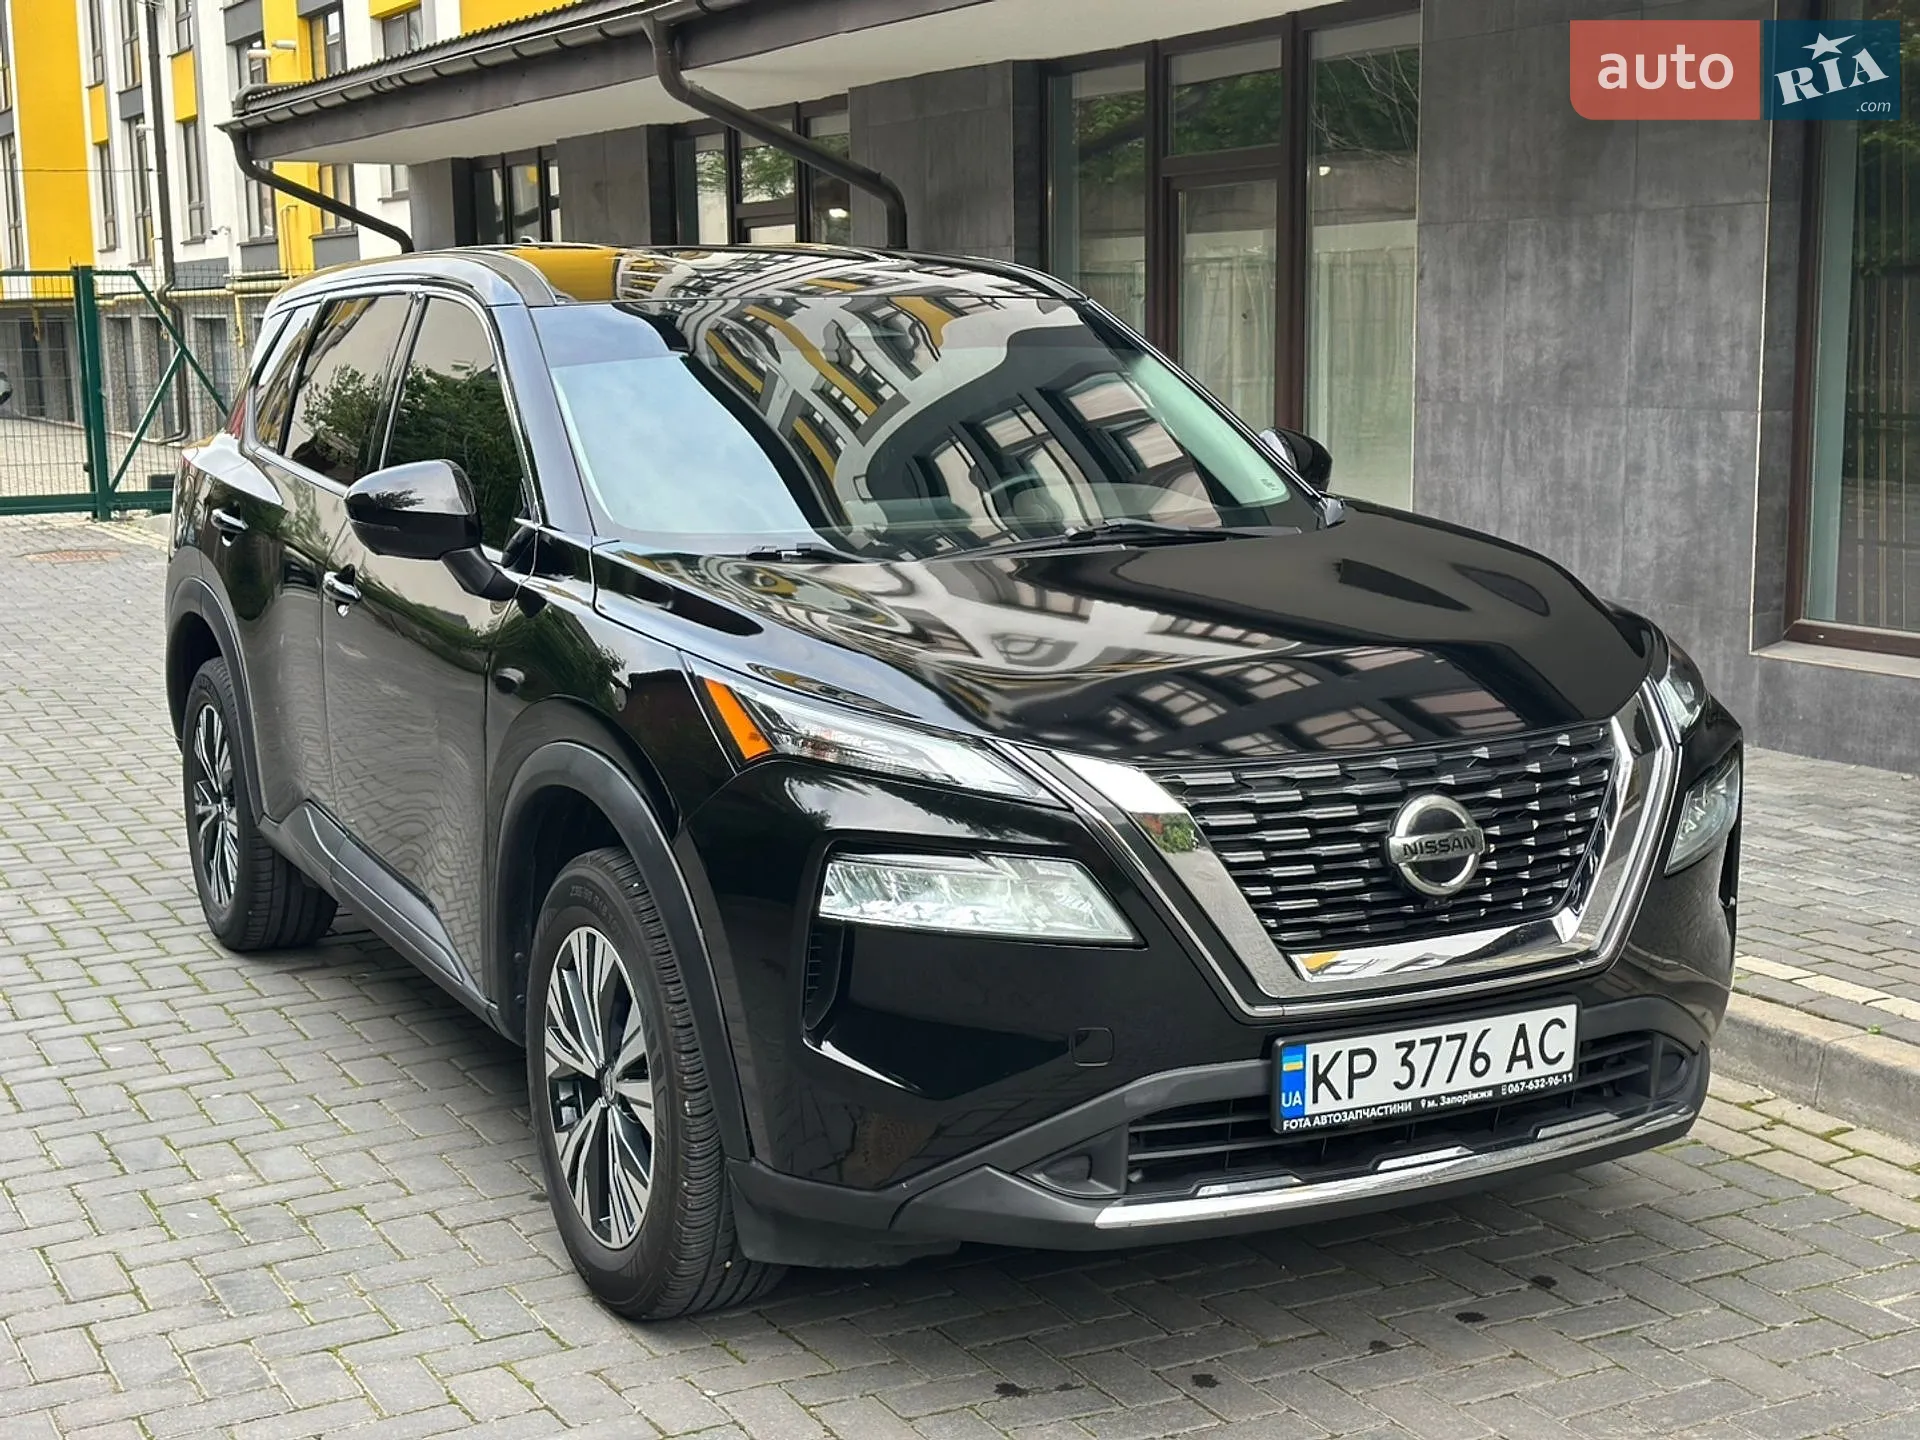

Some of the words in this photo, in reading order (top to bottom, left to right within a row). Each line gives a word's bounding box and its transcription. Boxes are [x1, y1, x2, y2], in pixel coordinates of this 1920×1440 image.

[1403, 836, 1475, 856] NISSAN
[1311, 1047, 1377, 1104] KP
[1393, 1028, 1491, 1091] 3776
[1505, 1018, 1567, 1073] AC
[1281, 1090, 1302, 1107] UA
[1312, 1101, 1412, 1127] АВТОЗАПЧАСТИНИ
[1507, 1073, 1573, 1096] 067-632-96-11
